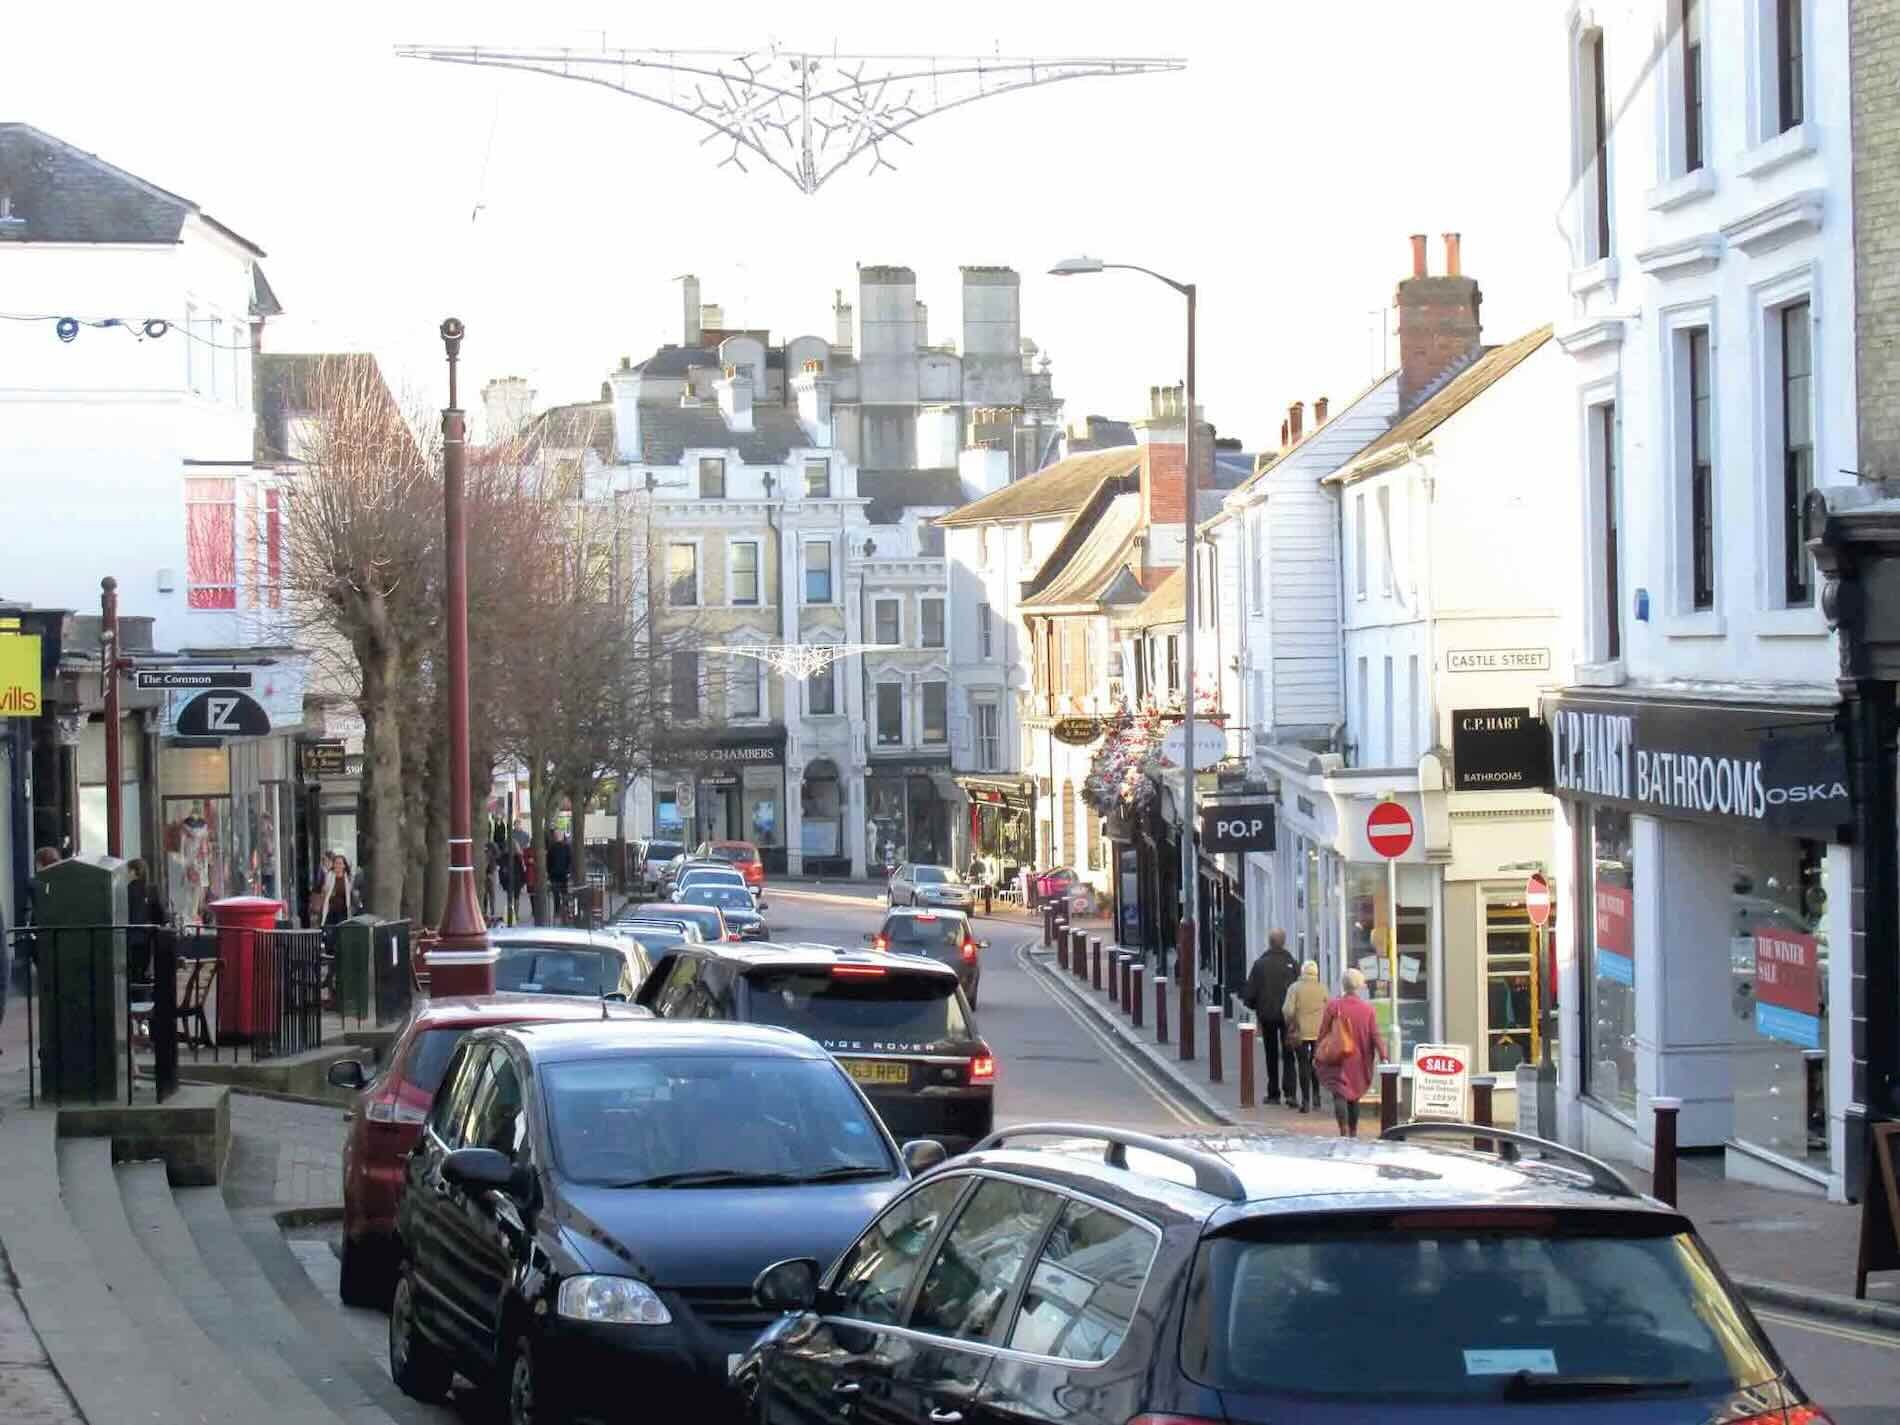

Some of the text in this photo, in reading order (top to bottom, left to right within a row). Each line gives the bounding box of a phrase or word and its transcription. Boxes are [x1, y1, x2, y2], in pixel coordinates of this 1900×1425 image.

[1452, 653, 1545, 667] CASTLE STREET
[143, 674, 212, 684] The Common
[1463, 716, 1520, 731] C.P. HART
[710, 747, 776, 760] CHAMBERS
[1583, 711, 1632, 799] HART
[1463, 771, 1523, 782] BATHROOMS
[1637, 750, 1765, 819] BATHROOMS
[1765, 782, 1849, 804] OSKA
[872, 1043, 935, 1052] ROVER
[1425, 1058, 1456, 1073] SALE
